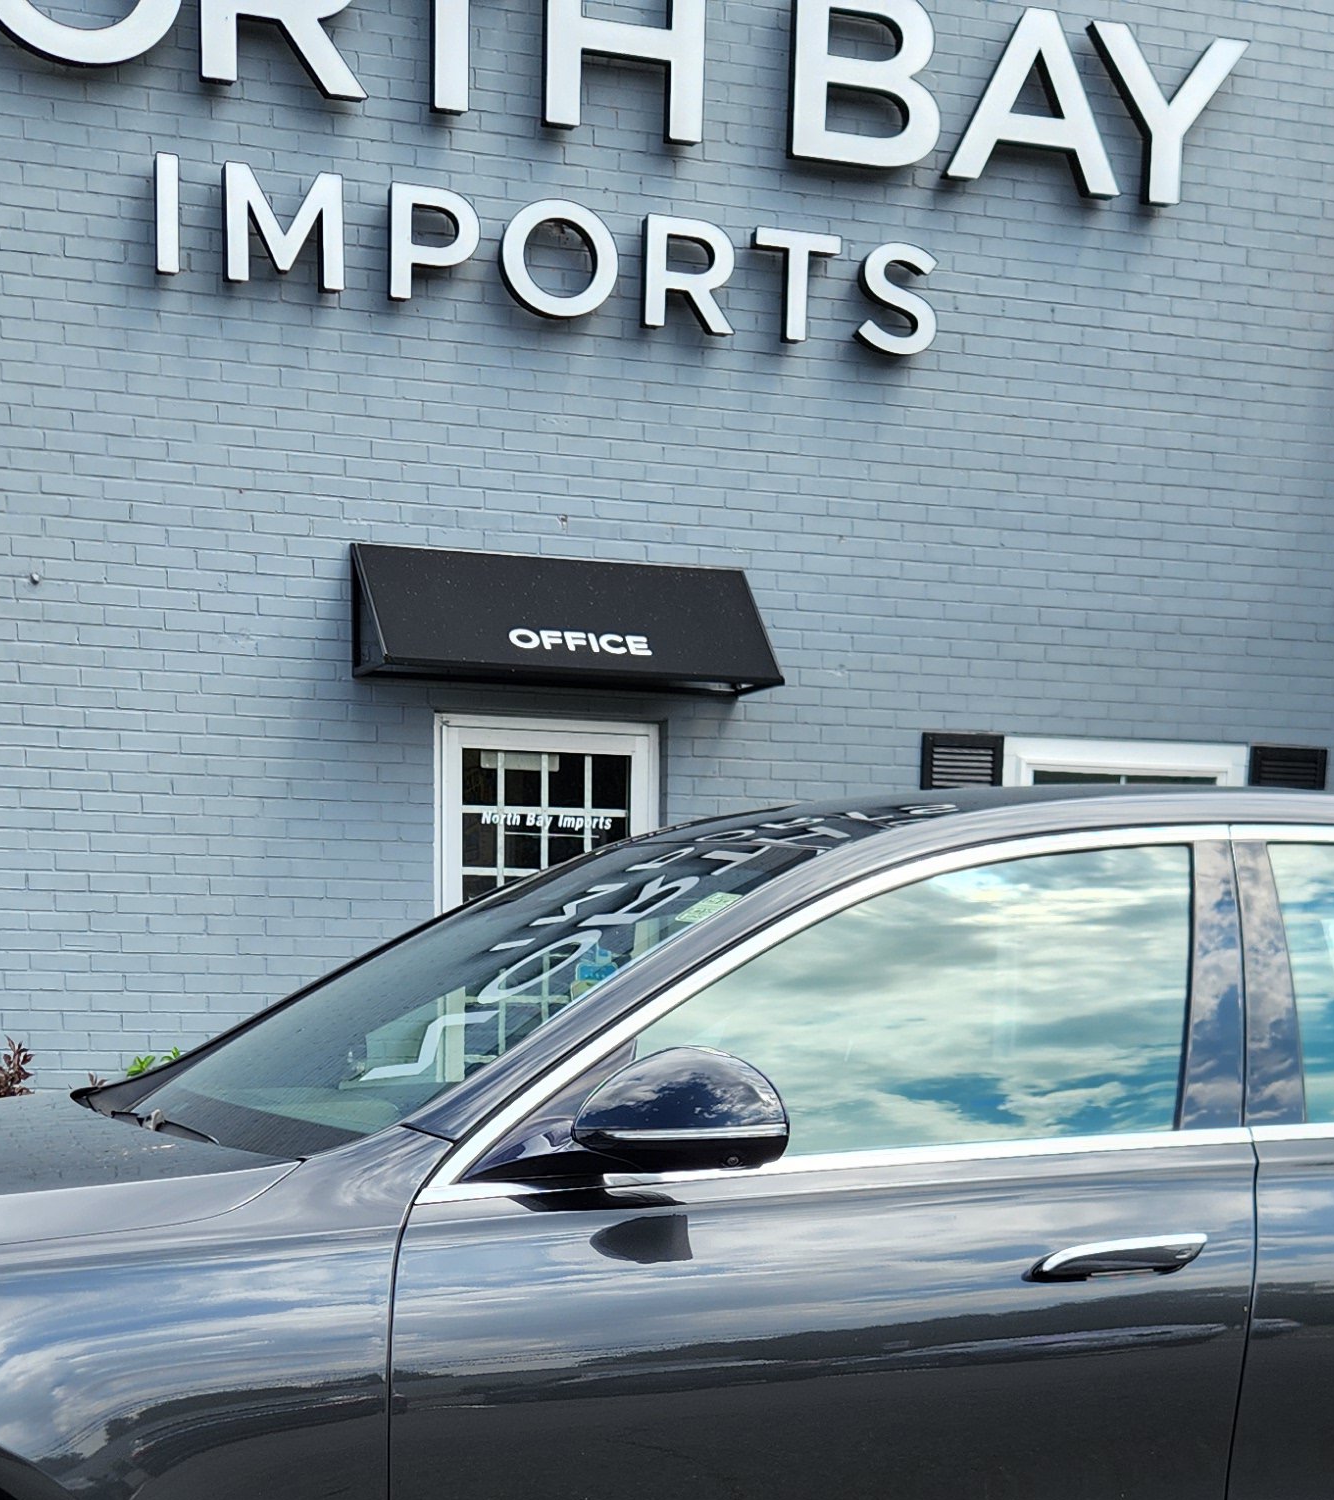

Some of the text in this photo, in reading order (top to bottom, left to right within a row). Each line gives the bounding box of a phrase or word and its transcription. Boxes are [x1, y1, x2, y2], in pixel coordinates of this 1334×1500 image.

[787, 0, 1251, 207] BAY
[154, 151, 940, 356] IMPORTS
[508, 627, 654, 657] OFFICE
[481, 811, 613, 831] North Bay Imports
